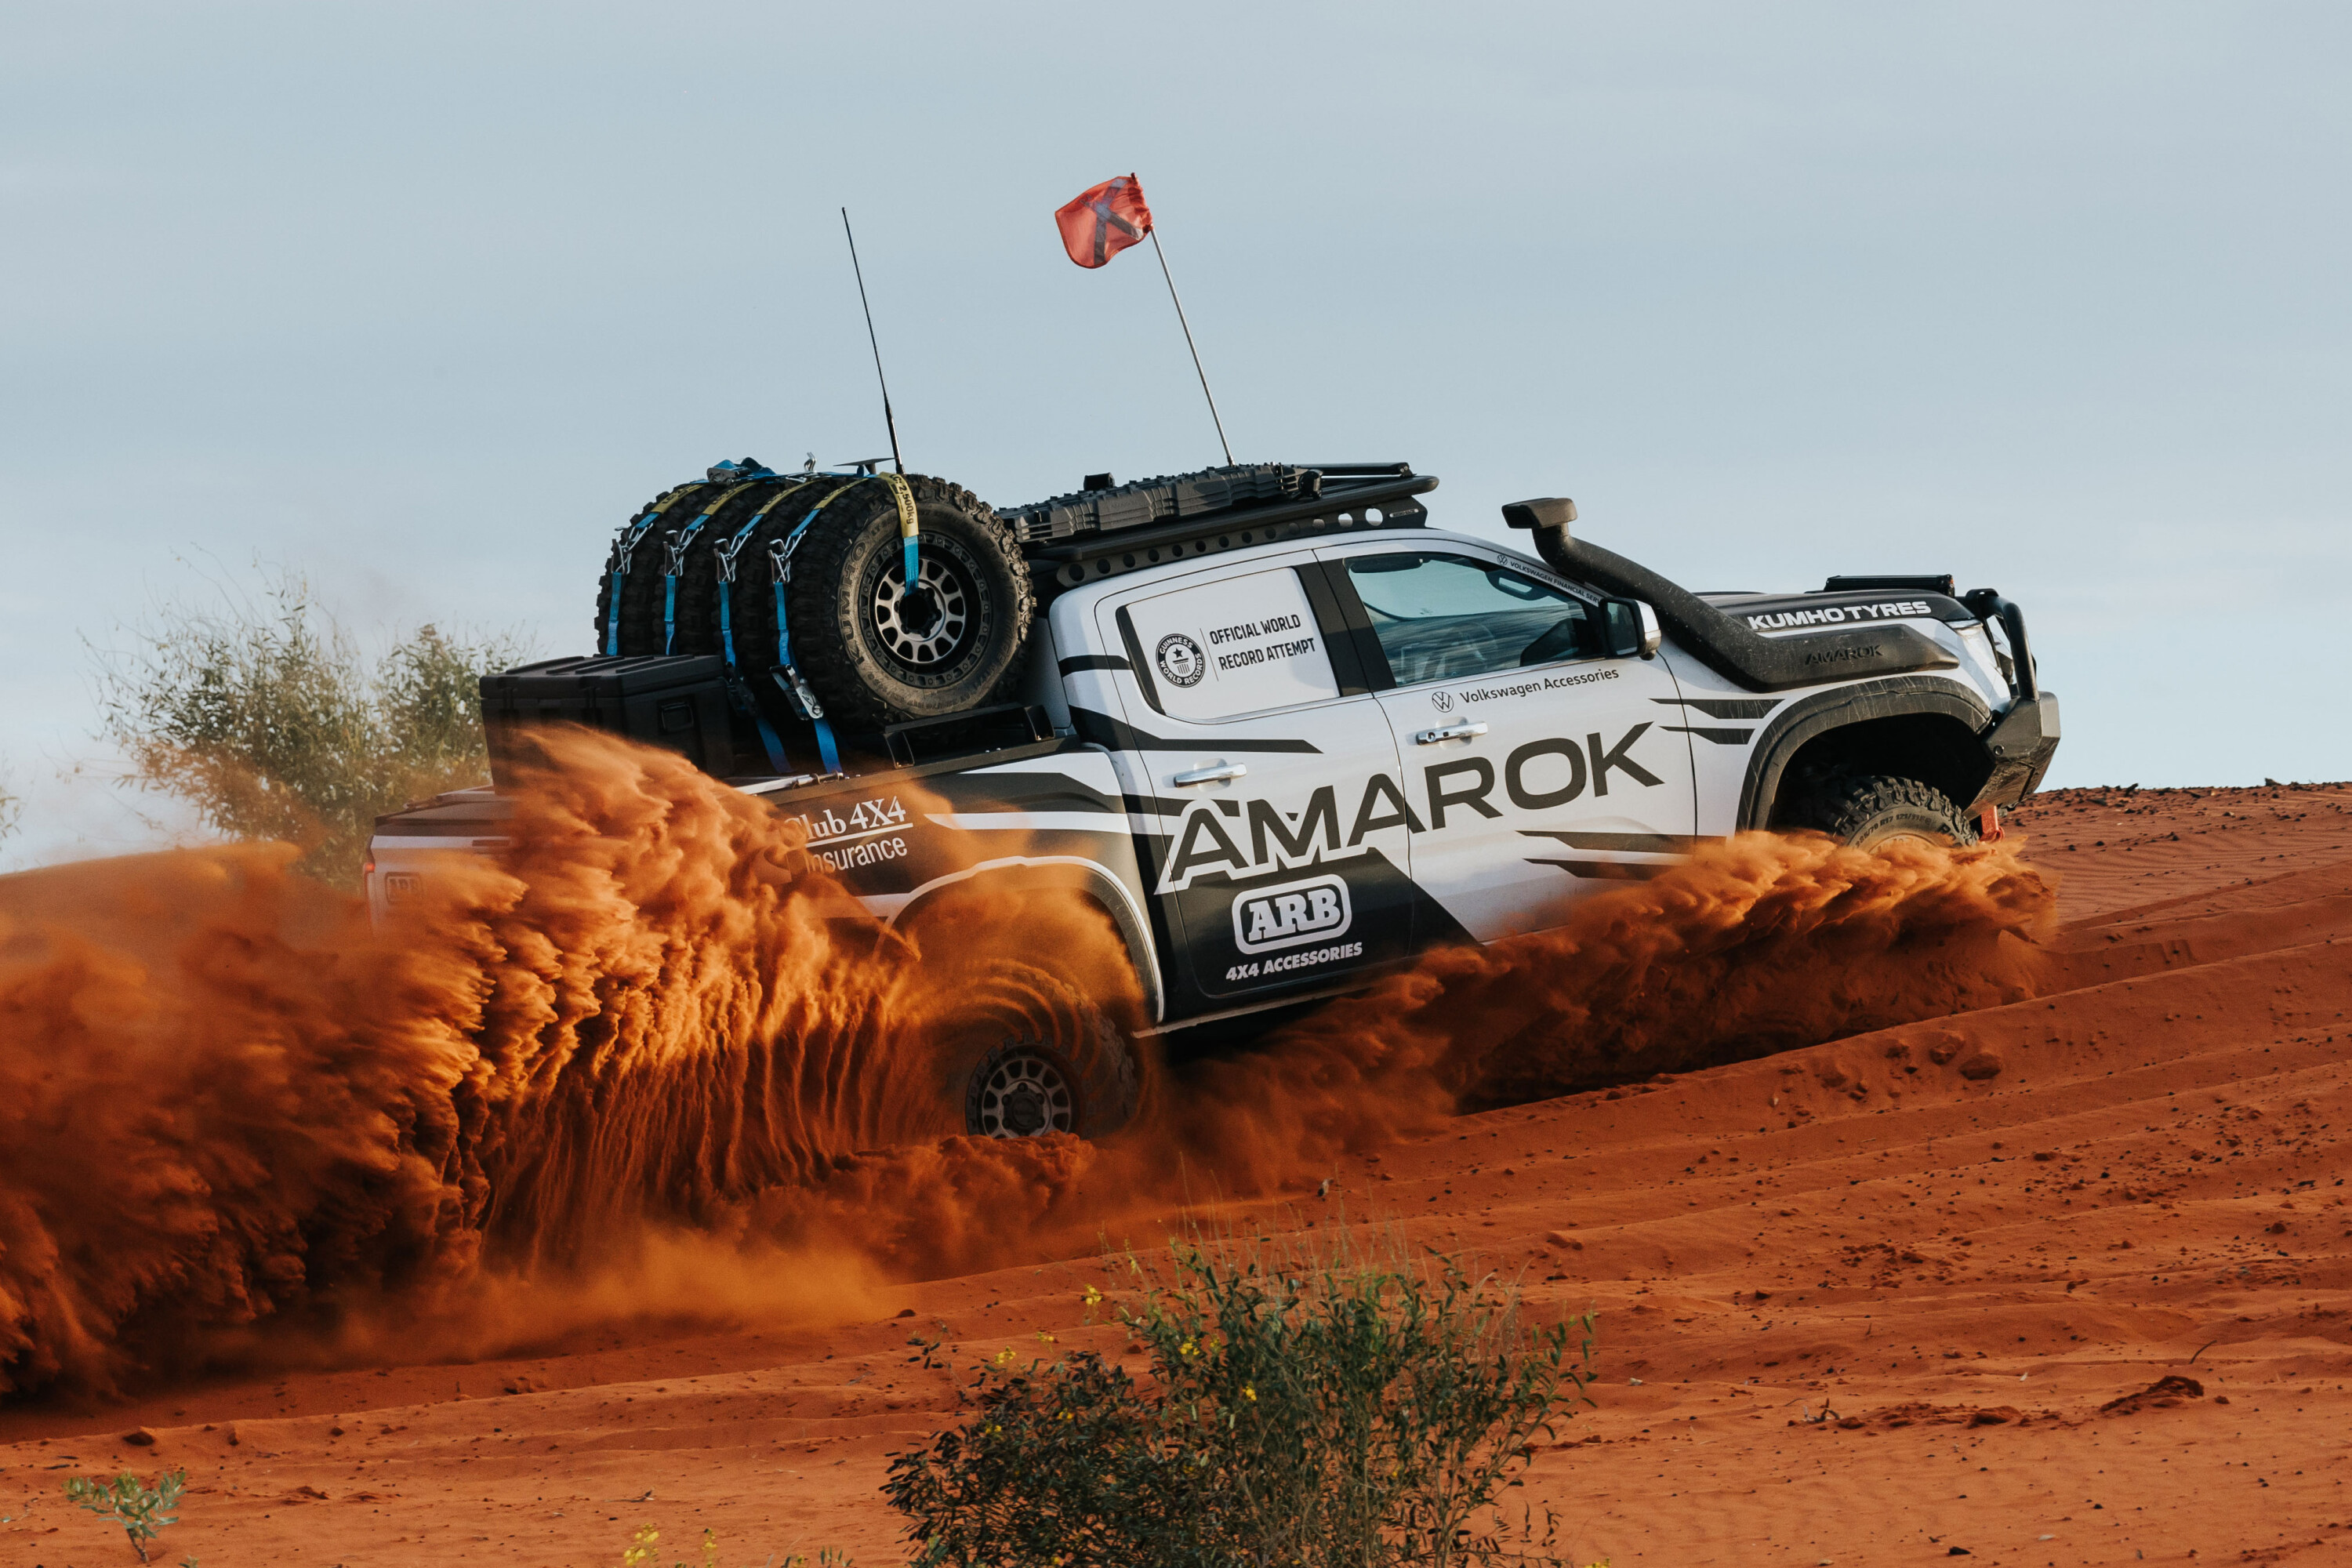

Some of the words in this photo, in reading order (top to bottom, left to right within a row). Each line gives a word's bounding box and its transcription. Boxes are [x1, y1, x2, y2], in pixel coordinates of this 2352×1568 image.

[898, 485, 915, 524] 2,500kg
[1510, 561, 1554, 583] VOLKSWAGEN
[1553, 579, 1585, 597] FINANCIAL
[839, 541, 866, 666] KUMHO
[1748, 607, 1846, 630] KUMHO
[1844, 601, 1932, 619] TYRES
[1159, 637, 1193, 655] GUINNESS
[1209, 622, 1261, 644] OFFICIAL
[1260, 614, 1301, 634] WORLD
[1160, 660, 1182, 684] WORLD
[1184, 652, 1203, 684] RECORDS
[1218, 648, 1265, 670] RECORD
[1265, 637, 1316, 661] ATTEMPT
[1805, 644, 1884, 666] AMAROK
[1459, 681, 1542, 703] Volkswagen
[1544, 669, 1620, 690] Accessories
[849, 795, 906, 829] 4X4
[1167, 720, 1666, 884] AMAROK
[1248, 888, 1341, 942] ARB
[1225, 963, 1260, 981] 4X4
[1262, 942, 1363, 975] ACCESSORIES
